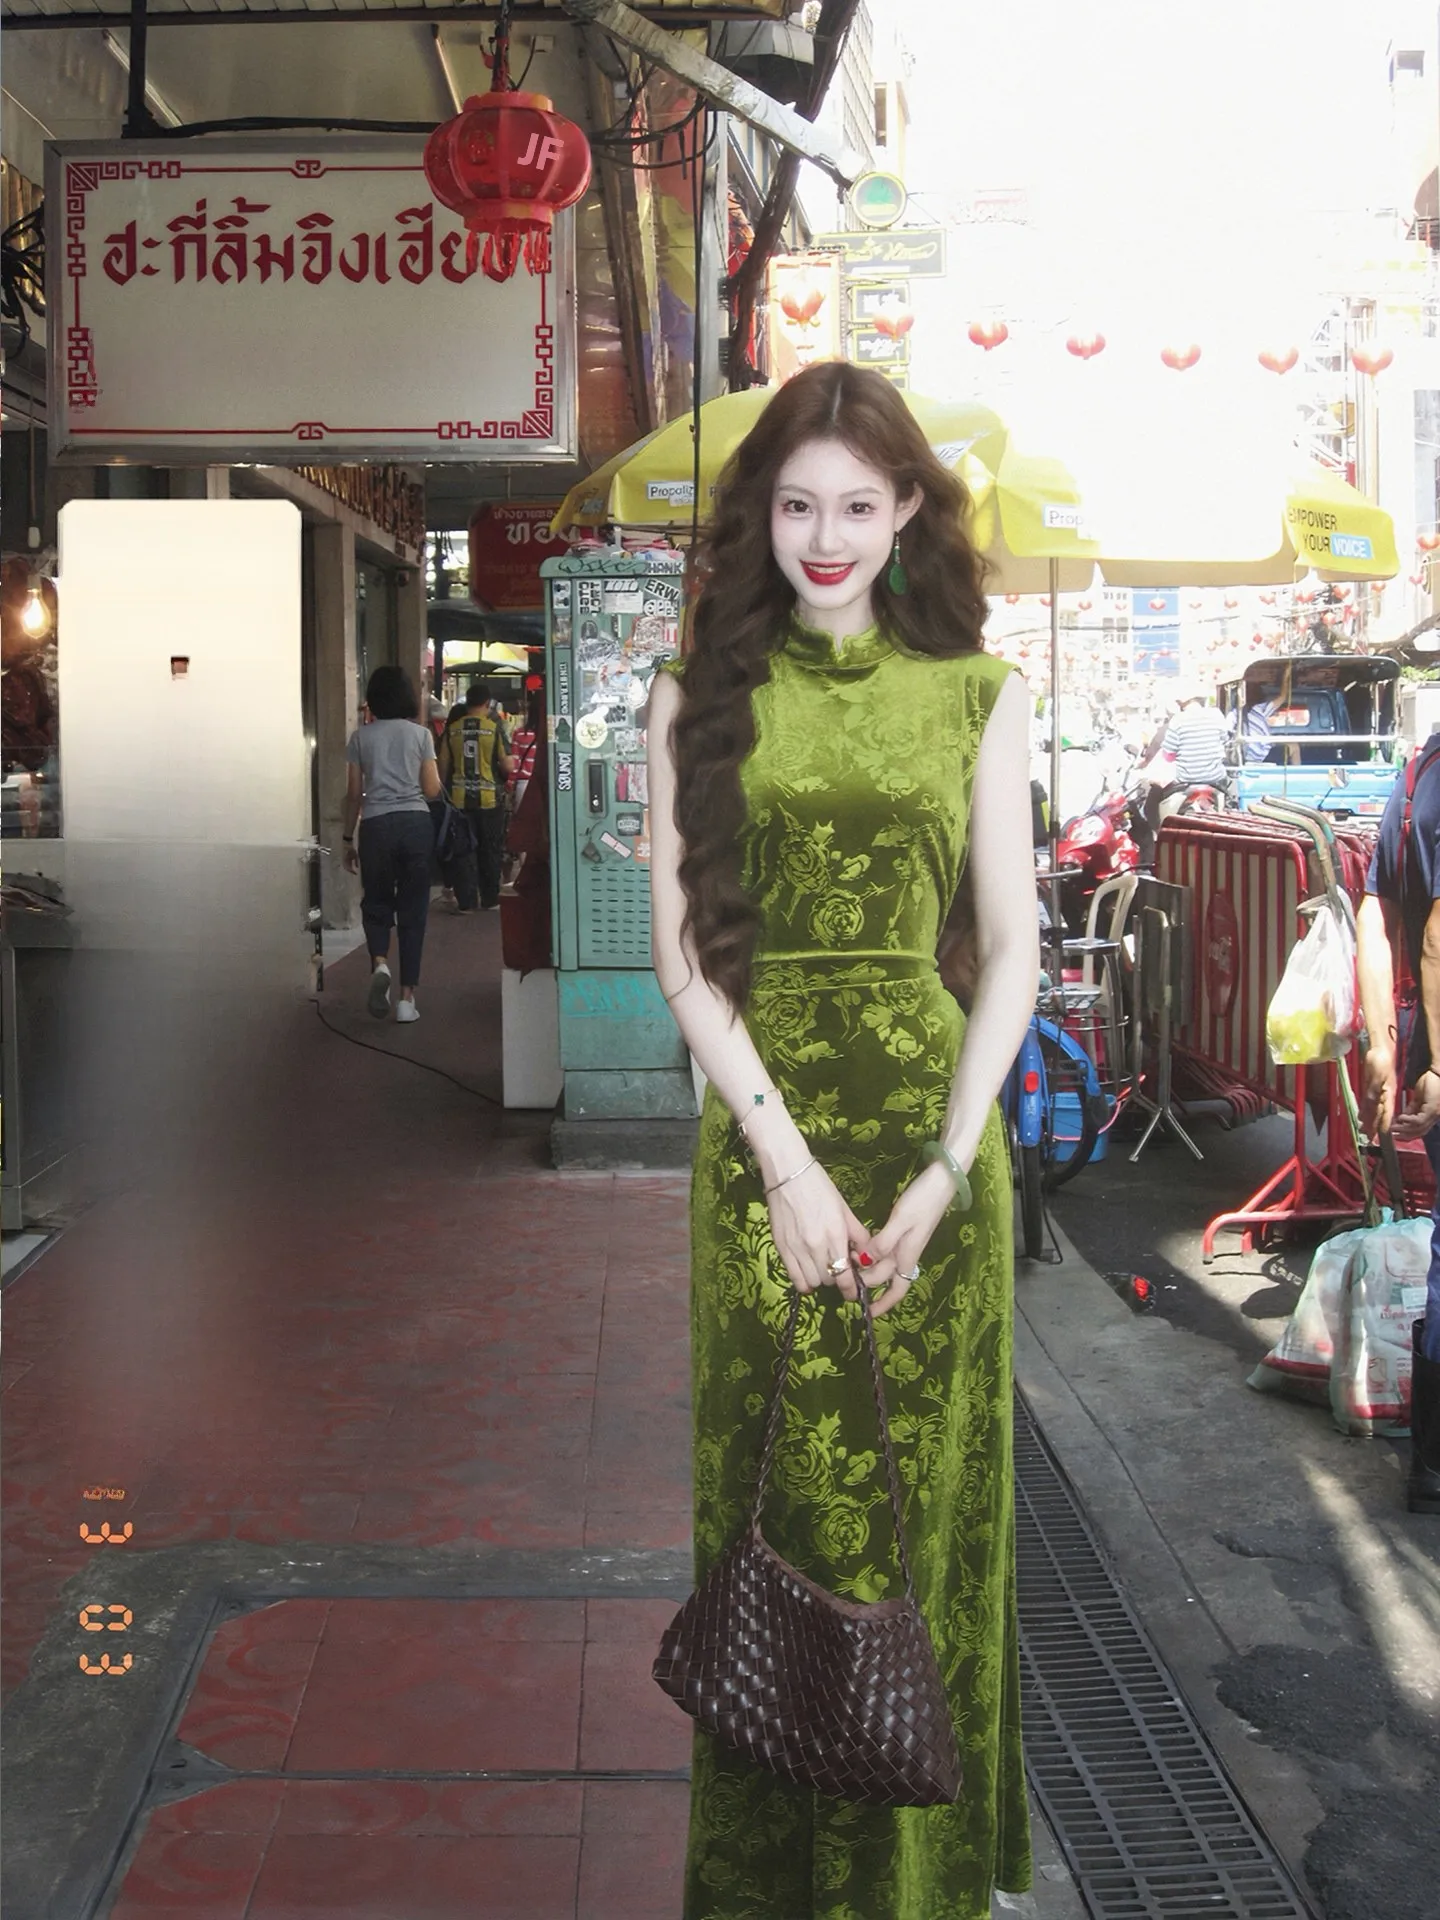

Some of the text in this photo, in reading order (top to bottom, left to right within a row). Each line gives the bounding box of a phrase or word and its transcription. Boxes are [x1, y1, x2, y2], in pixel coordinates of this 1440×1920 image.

[1288, 507, 1338, 531] EMPOWER
[1303, 534, 1368, 558] YOUR VOICE
[464, 740, 480, 775] 9
